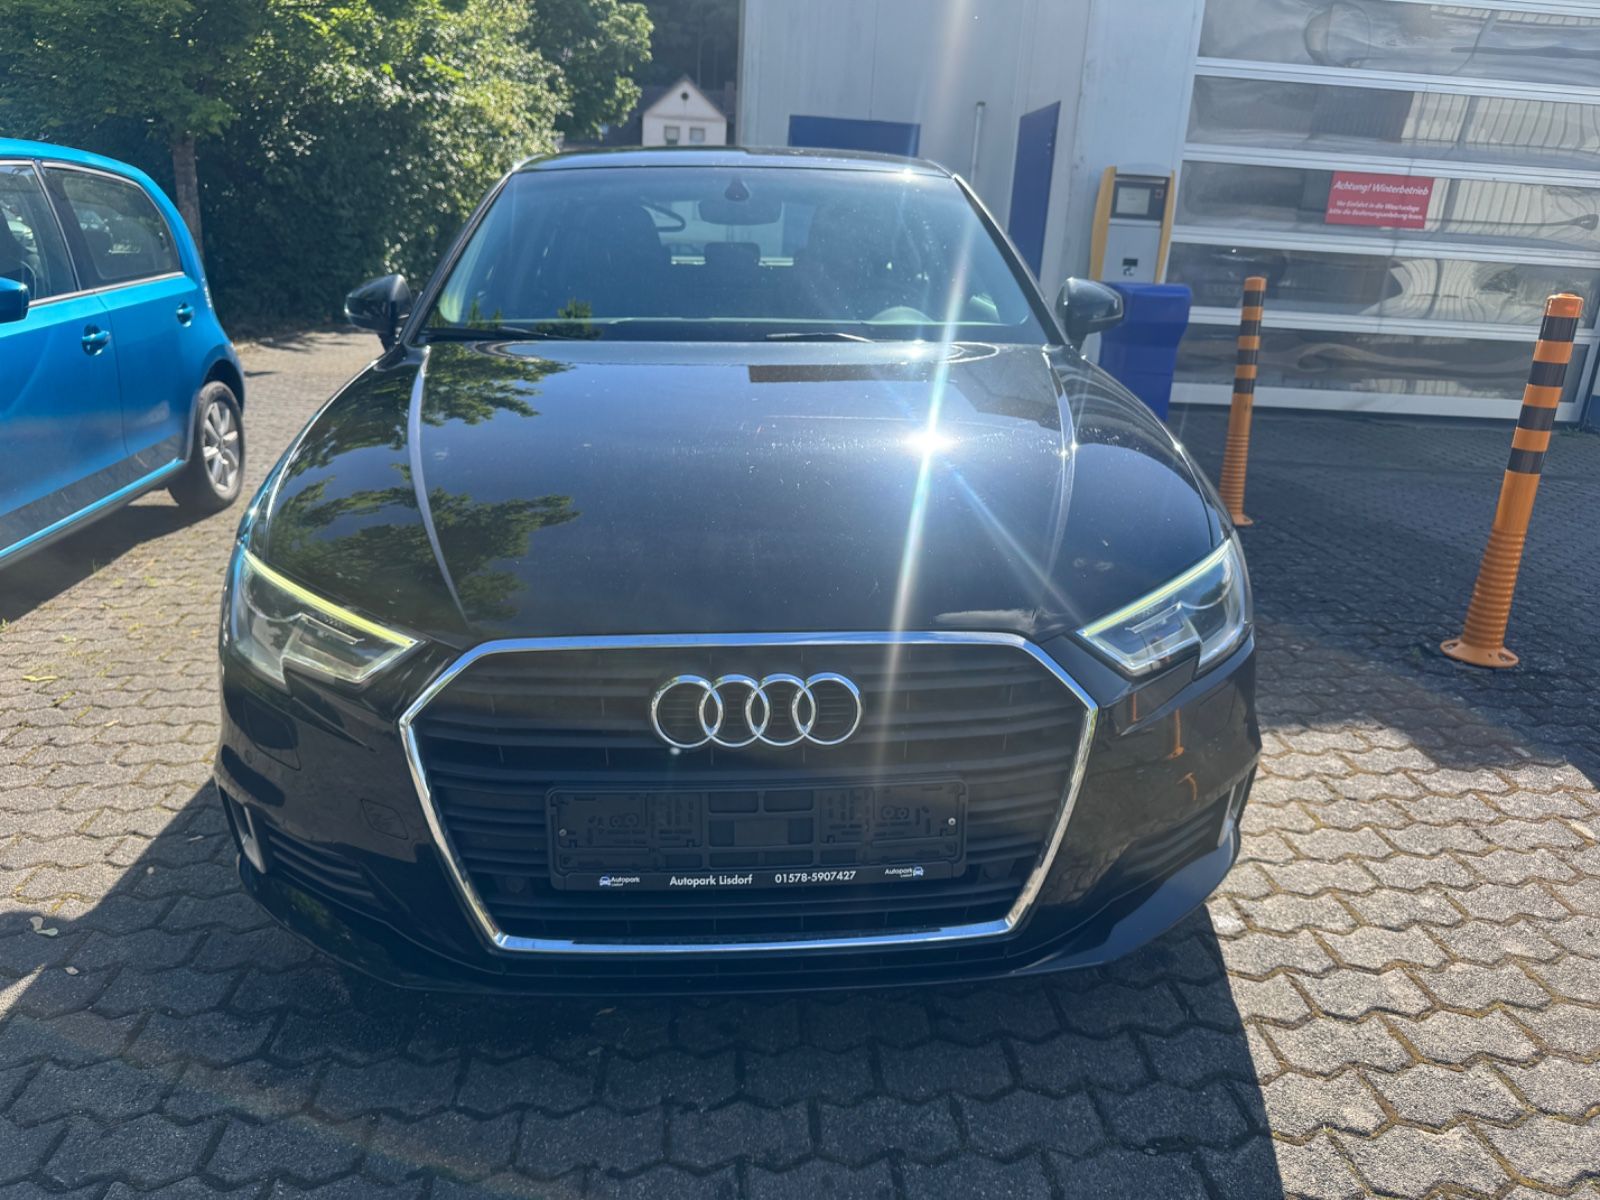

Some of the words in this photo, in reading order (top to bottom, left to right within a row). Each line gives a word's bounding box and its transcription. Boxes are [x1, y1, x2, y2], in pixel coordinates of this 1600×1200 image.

[1333, 181, 1371, 194] Achtung!
[1372, 183, 1429, 195] Winterbetrieb
[885, 867, 913, 875] Autopark
[611, 876, 640, 884] Autopark
[669, 875, 716, 887] Autopark
[719, 873, 753, 886] Lisdorf
[775, 870, 857, 883] 01578-5907427
